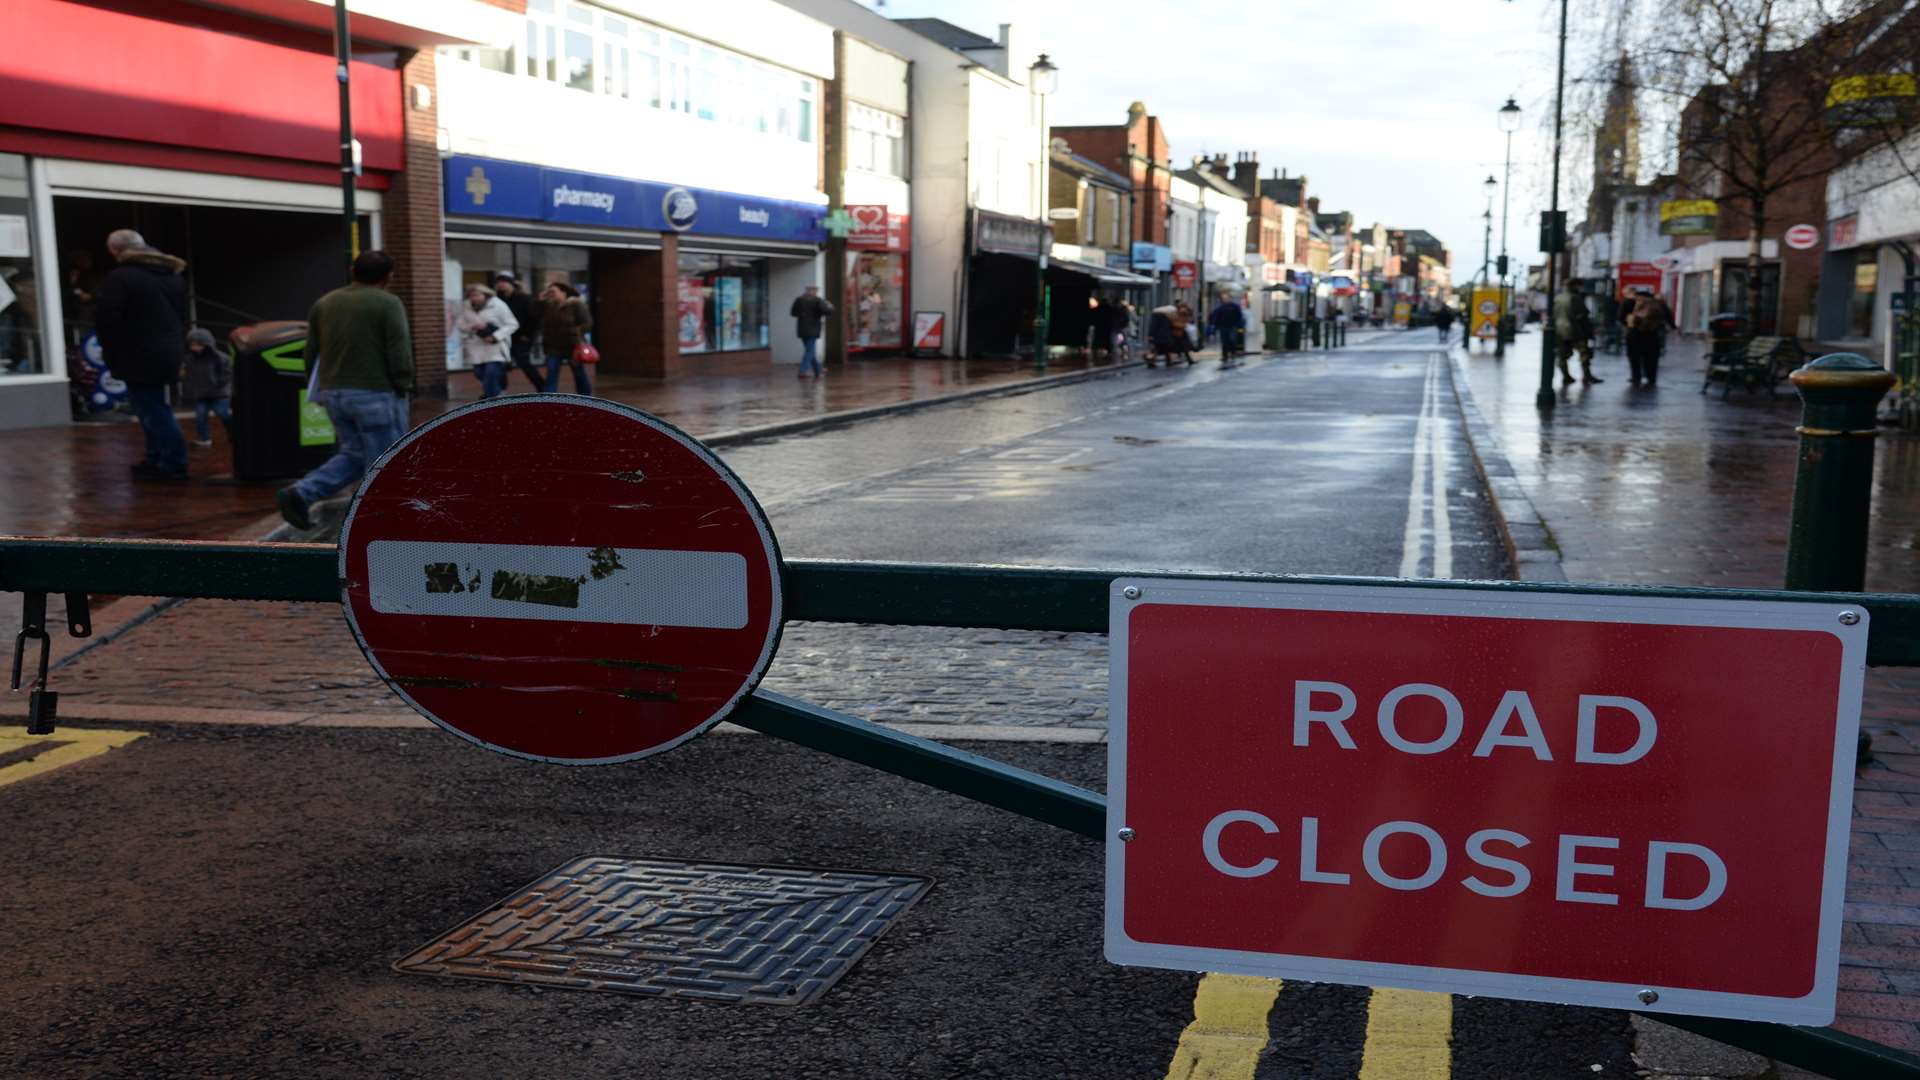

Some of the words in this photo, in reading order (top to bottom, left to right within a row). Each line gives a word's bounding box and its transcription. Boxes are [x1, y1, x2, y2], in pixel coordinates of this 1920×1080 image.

[553, 184, 615, 213] pharmacy
[1293, 680, 1658, 765] ROAD
[1202, 809, 1728, 911] CLOSED
